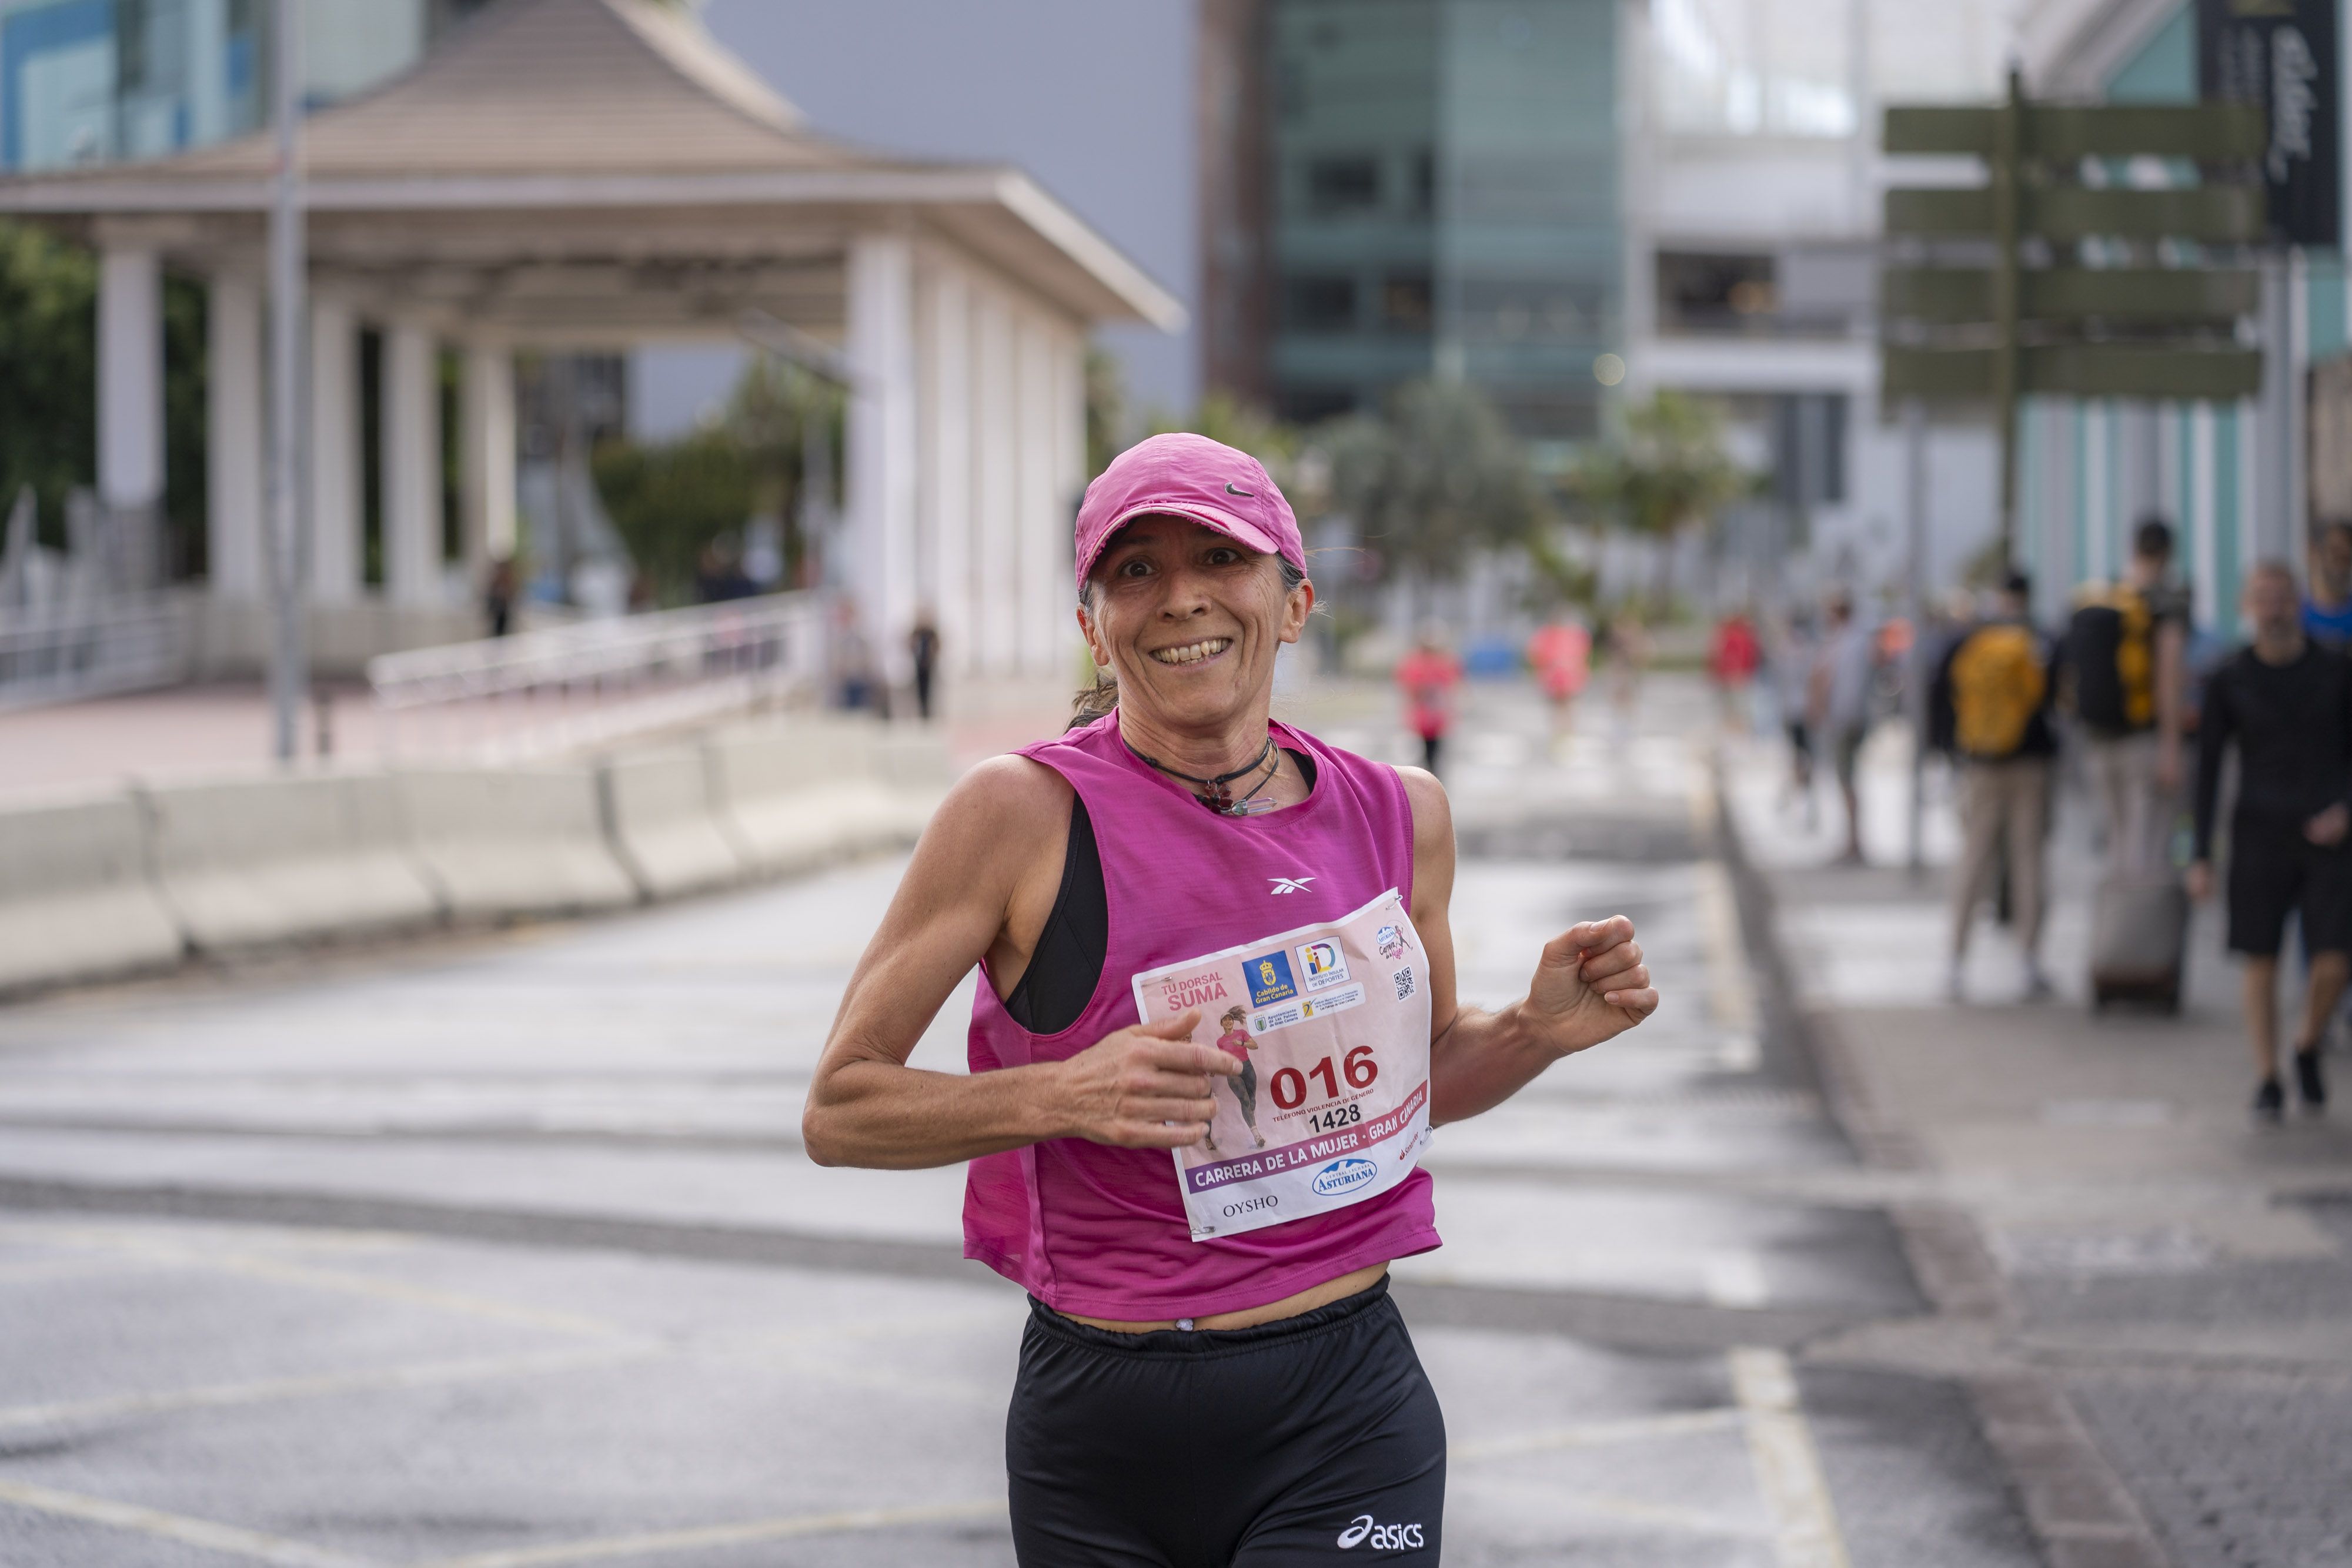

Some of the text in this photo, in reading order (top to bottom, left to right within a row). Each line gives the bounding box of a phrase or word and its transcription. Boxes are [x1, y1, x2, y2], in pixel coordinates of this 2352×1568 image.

[1379, 942, 1395, 955] Carrera
[1161, 972, 1222, 995] TU DORSAL
[1318, 974, 1344, 986] DEPORTES
[1168, 982, 1228, 1011] SUMA
[1257, 987, 1279, 997] Cabildo
[1271, 989, 1294, 999] Canaria
[1268, 1009, 1297, 1020] Ayuntamiento
[1270, 1045, 1378, 1110] 016
[1272, 1109, 1306, 1122] TELÉFONO
[1307, 1100, 1342, 1114] VIOLENCIA
[1351, 1088, 1374, 1101] GÉNERO
[1309, 1104, 1361, 1133] 1428
[1195, 1160, 1262, 1187] CARRERA
[1265, 1154, 1285, 1171] DE
[1288, 1148, 1308, 1165] LA
[1310, 1133, 1359, 1159] MUJER
[1369, 1116, 1398, 1140] GRAN
[1318, 1168, 1374, 1192] ASTURIANA
[1325, 1171, 1347, 1180] CENTRAL
[1223, 1195, 1278, 1217] OYSHO
[1370, 1523, 1424, 1550] asics
